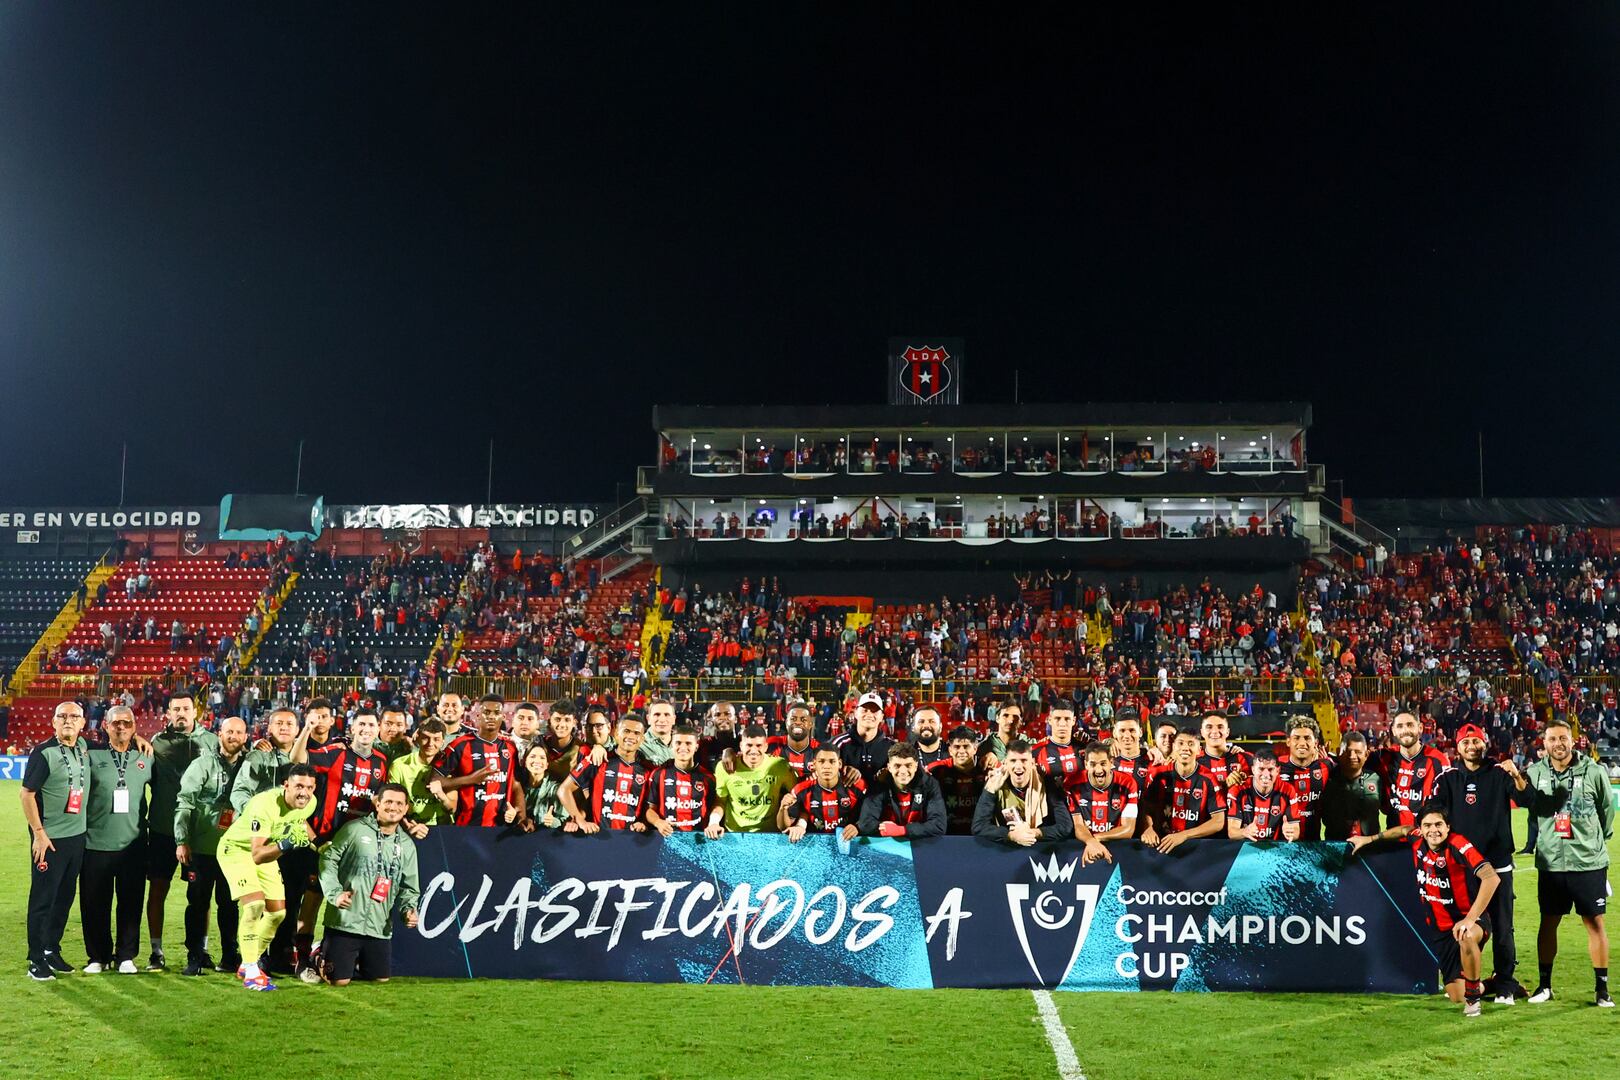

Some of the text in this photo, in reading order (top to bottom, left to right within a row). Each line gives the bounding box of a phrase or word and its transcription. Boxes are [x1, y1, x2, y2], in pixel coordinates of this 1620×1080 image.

[0, 511, 201, 527] ER EN VELOCIDAD
[614, 790, 639, 807] kölbi
[1396, 787, 1422, 801] kölbi
[1172, 807, 1199, 822] kölbi
[1116, 884, 1228, 906] Concacaf
[417, 871, 973, 961] CLASIFICADOS A
[1115, 913, 1367, 945] CHAMPIONS
[1115, 952, 1190, 979] CUP
